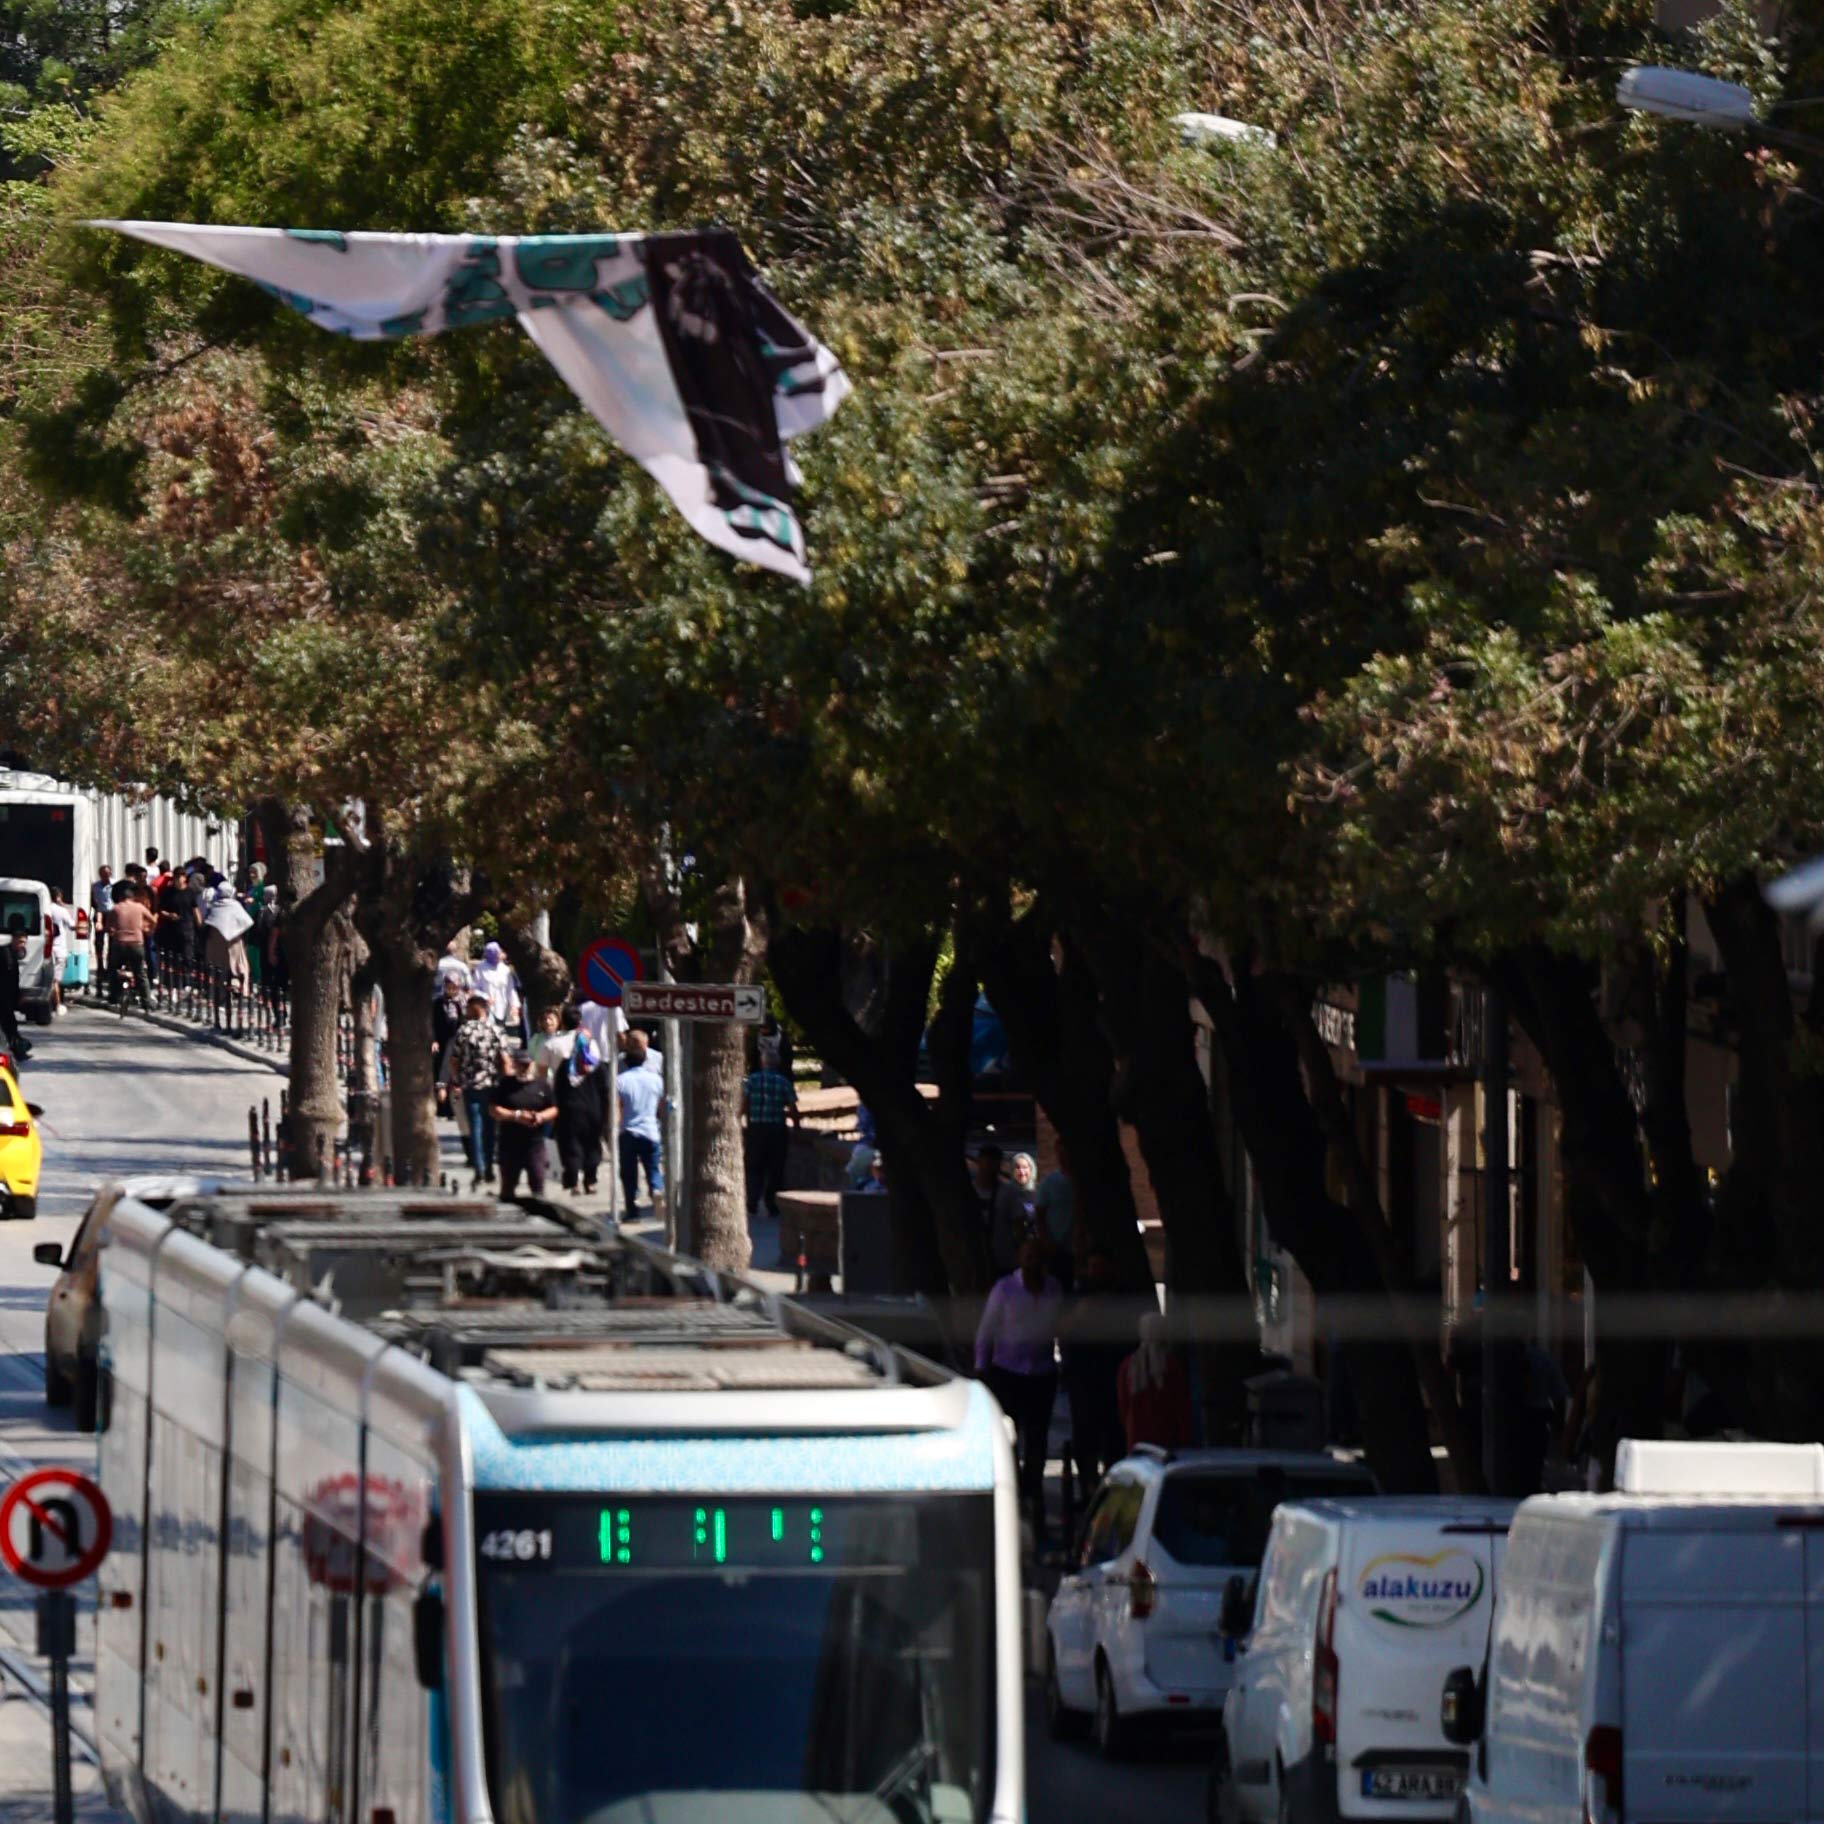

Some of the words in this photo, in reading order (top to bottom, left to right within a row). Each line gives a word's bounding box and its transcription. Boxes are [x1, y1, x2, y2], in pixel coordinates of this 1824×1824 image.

[629, 991, 734, 1012] Bedesten
[480, 1529, 552, 1560] 4261
[1363, 1575, 1471, 1599] alakuzu
